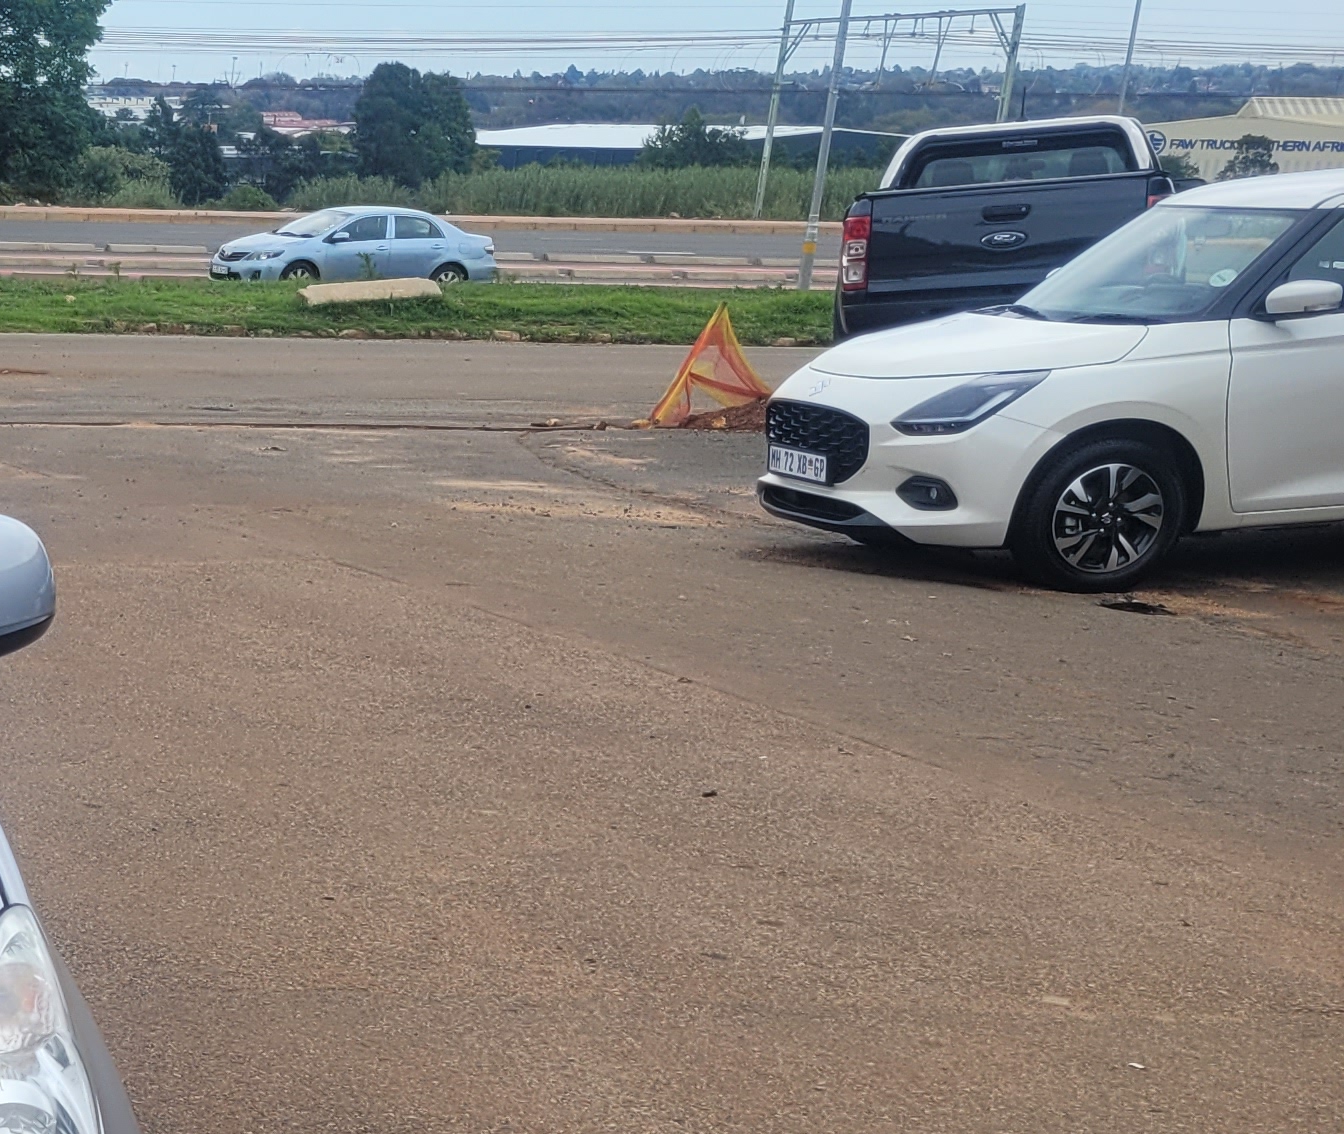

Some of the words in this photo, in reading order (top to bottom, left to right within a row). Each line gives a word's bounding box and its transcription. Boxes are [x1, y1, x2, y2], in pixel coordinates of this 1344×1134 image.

[1170, 139, 1197, 150] FAW
[1199, 139, 1242, 150] TRUCK
[1265, 140, 1312, 151] THERN
[784, 450, 794, 472] 72
[797, 453, 807, 475] XB
[813, 457, 825, 478] GP
